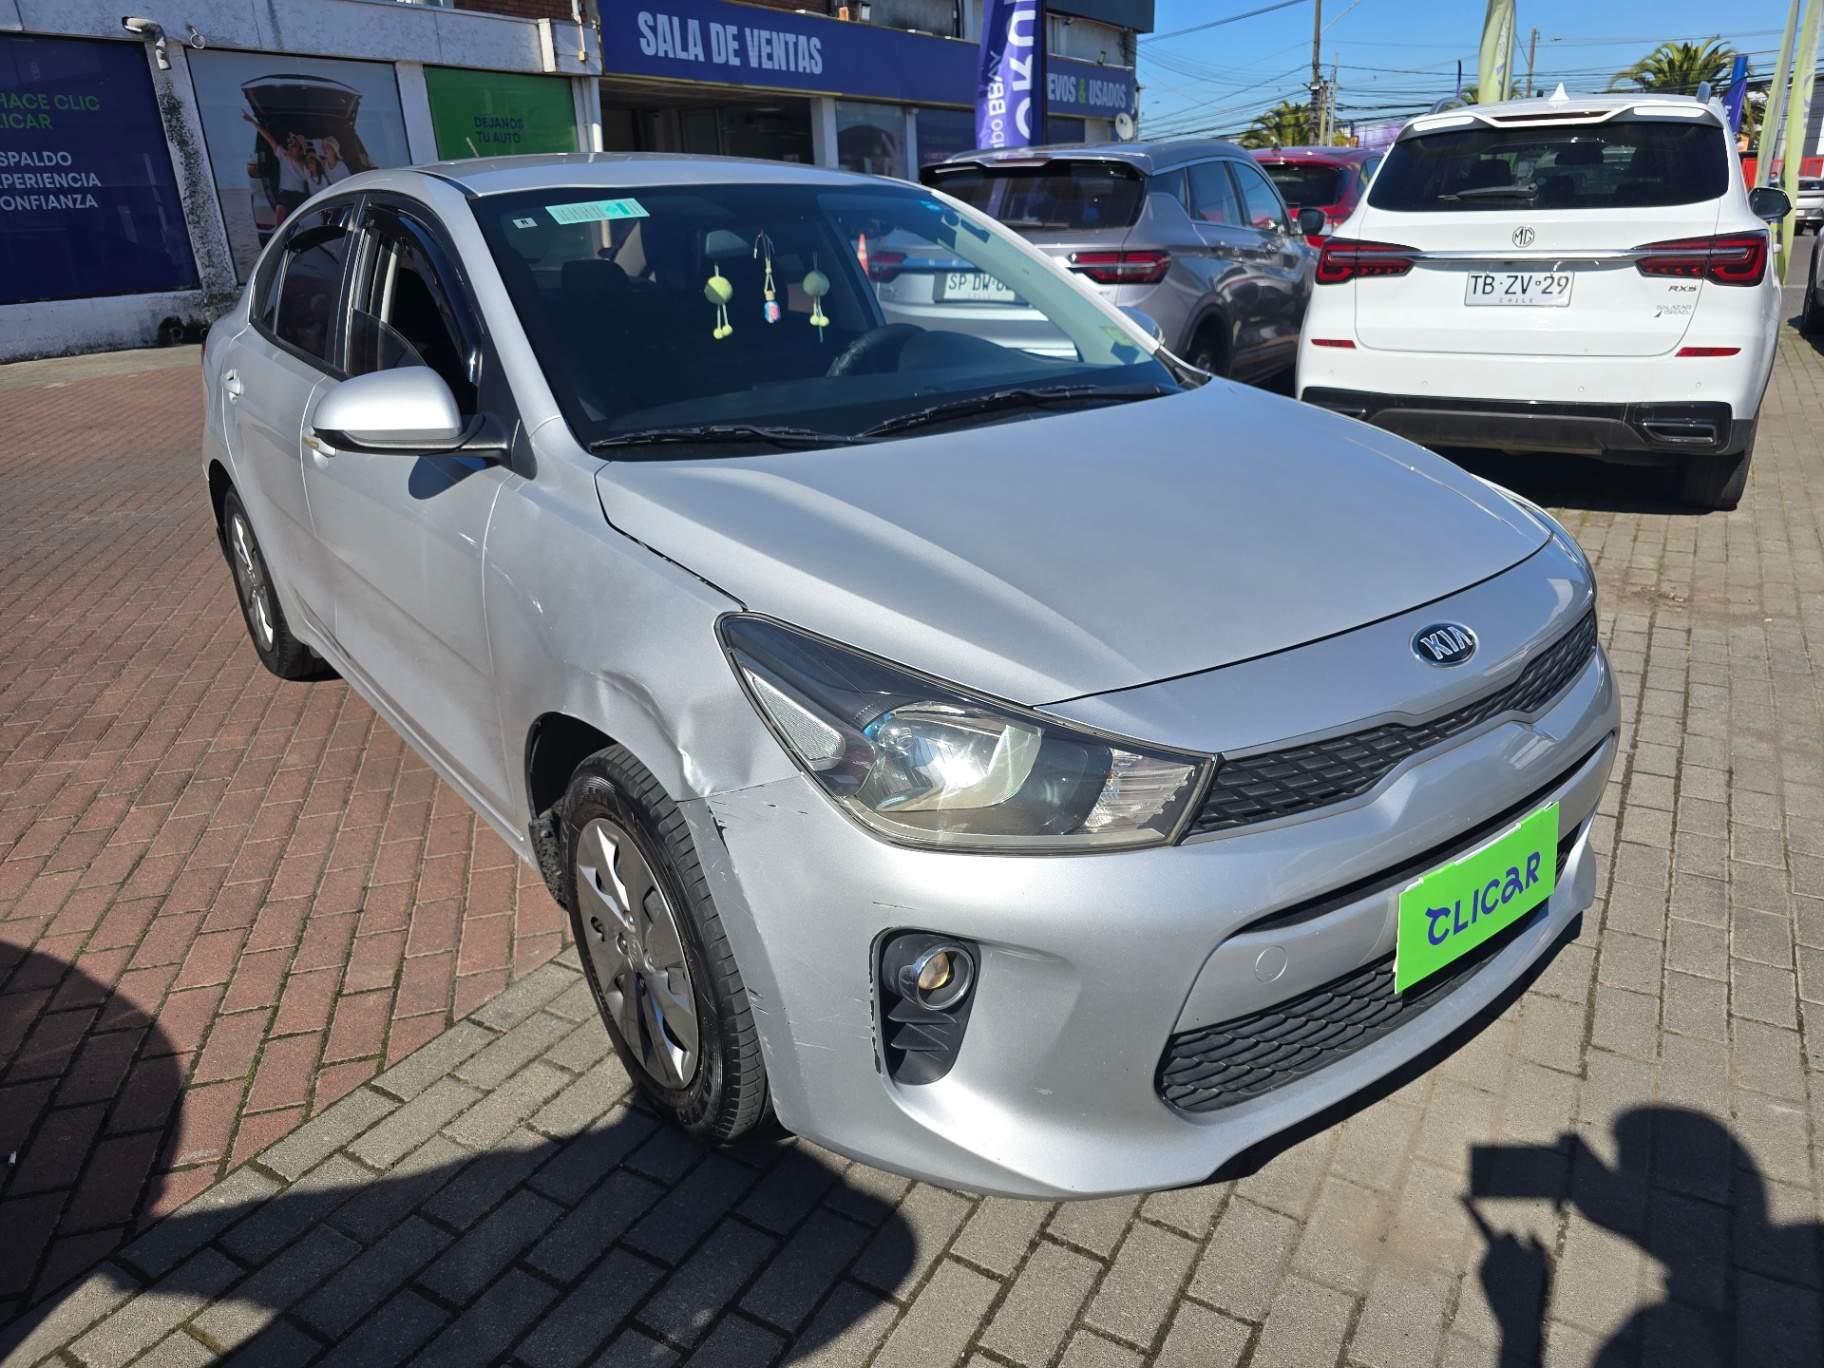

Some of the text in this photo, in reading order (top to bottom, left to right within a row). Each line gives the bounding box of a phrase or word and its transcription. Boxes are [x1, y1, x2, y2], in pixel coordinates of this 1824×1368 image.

[637, 11, 823, 75] SALA DE VENTAS
[1078, 77, 1087, 104] &
[1088, 80, 1127, 109] USADOS
[53, 94, 100, 111] CLIC
[0, 112, 53, 129] ICAR
[475, 130, 521, 144] TU AUTO
[0, 151, 72, 167] SPALDO
[0, 172, 102, 189] PERIENCIA
[0, 194, 98, 211] ONFIANZA
[1420, 626, 1473, 660] KIA
